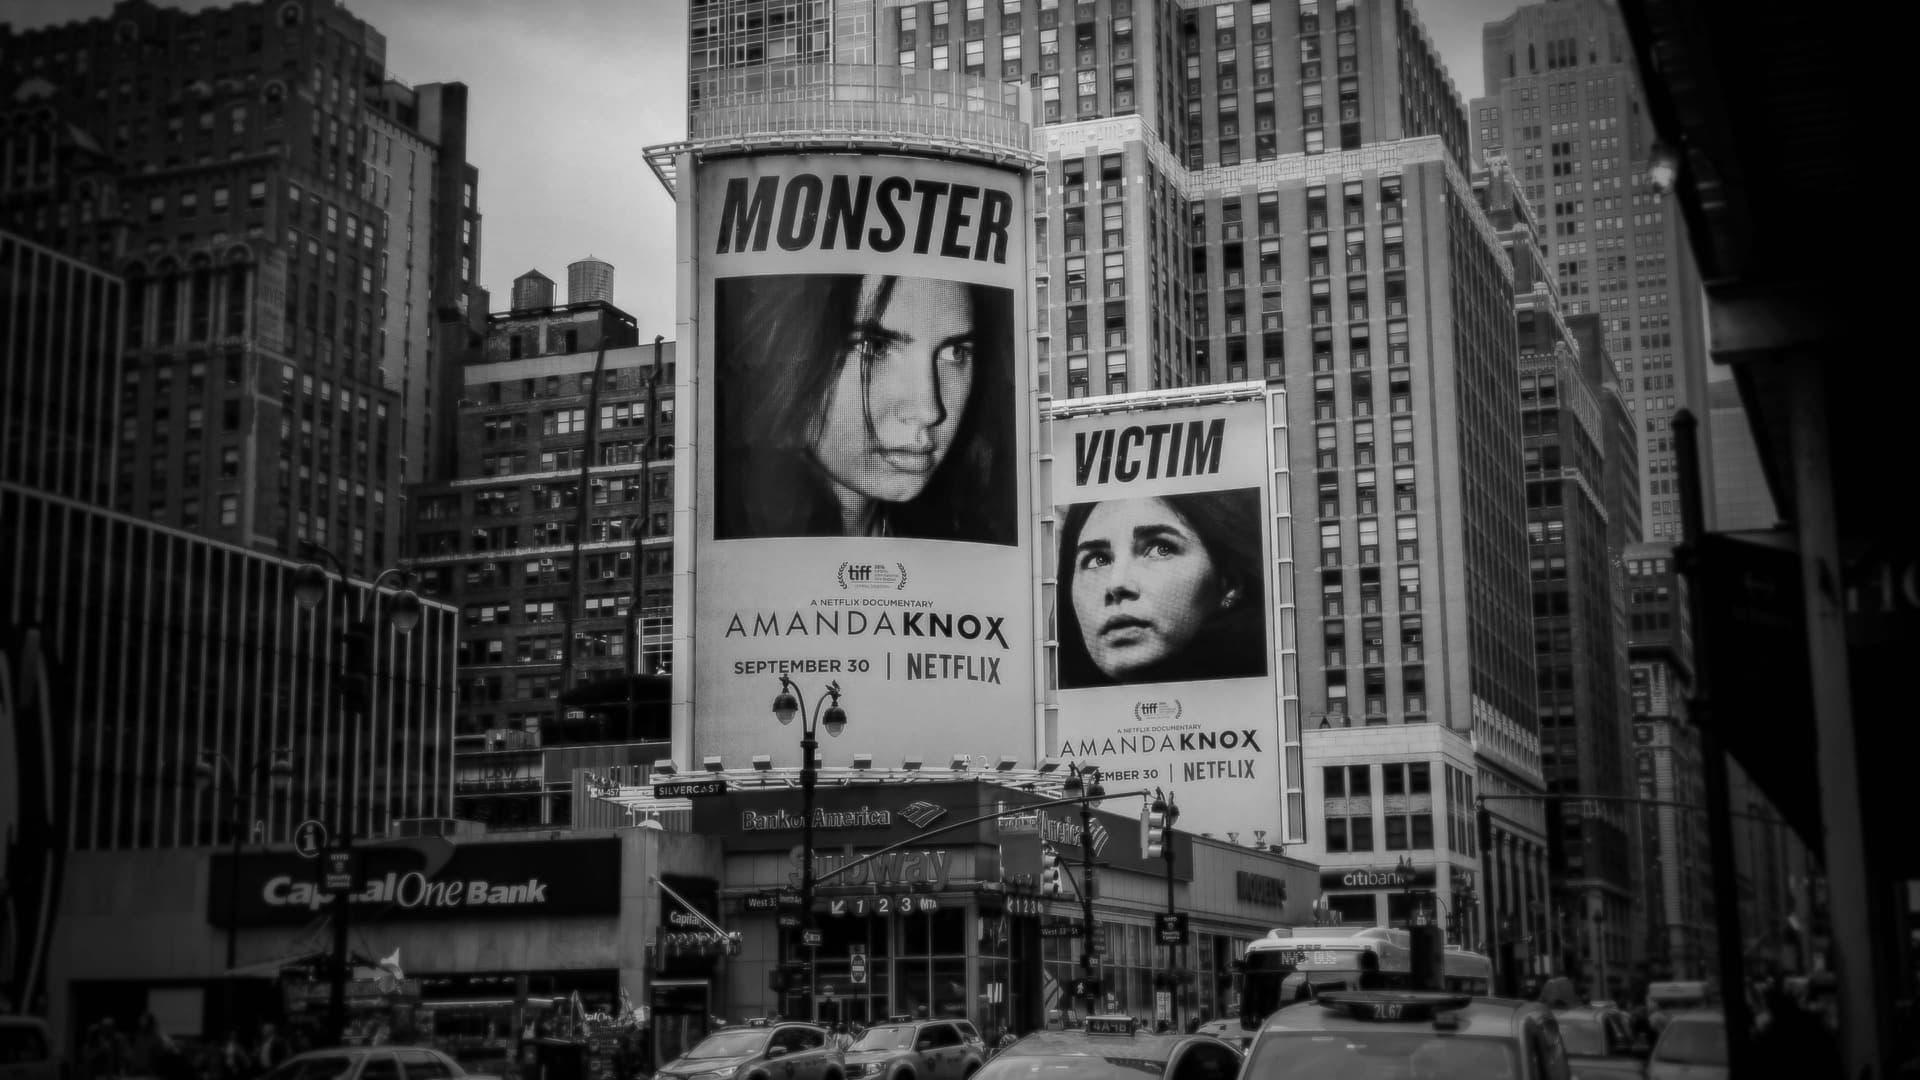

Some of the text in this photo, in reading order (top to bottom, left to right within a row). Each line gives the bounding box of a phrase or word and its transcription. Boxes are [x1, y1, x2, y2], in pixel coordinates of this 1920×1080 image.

[716, 173, 1012, 264] MONSTER
[1075, 418, 1225, 486] VICTIM
[849, 564, 871, 580] tiff
[862, 599, 934, 608] DOCUMENTARY
[734, 652, 1001, 685] SEPTEMBER 30 NETFLIX
[1141, 703, 1158, 715] tiff
[1151, 723, 1202, 733] DOCUMENTARY
[1098, 759, 1255, 782] EMBER 30 NETFLIX
[658, 783, 721, 796] SILVERCAST
[742, 808, 791, 831] Bank
[812, 803, 891, 828] America
[465, 879, 547, 906] Bank
[749, 898, 768, 908] West
[856, 897, 937, 913] 1 2 3 MTA
[1042, 928, 1057, 936] West
